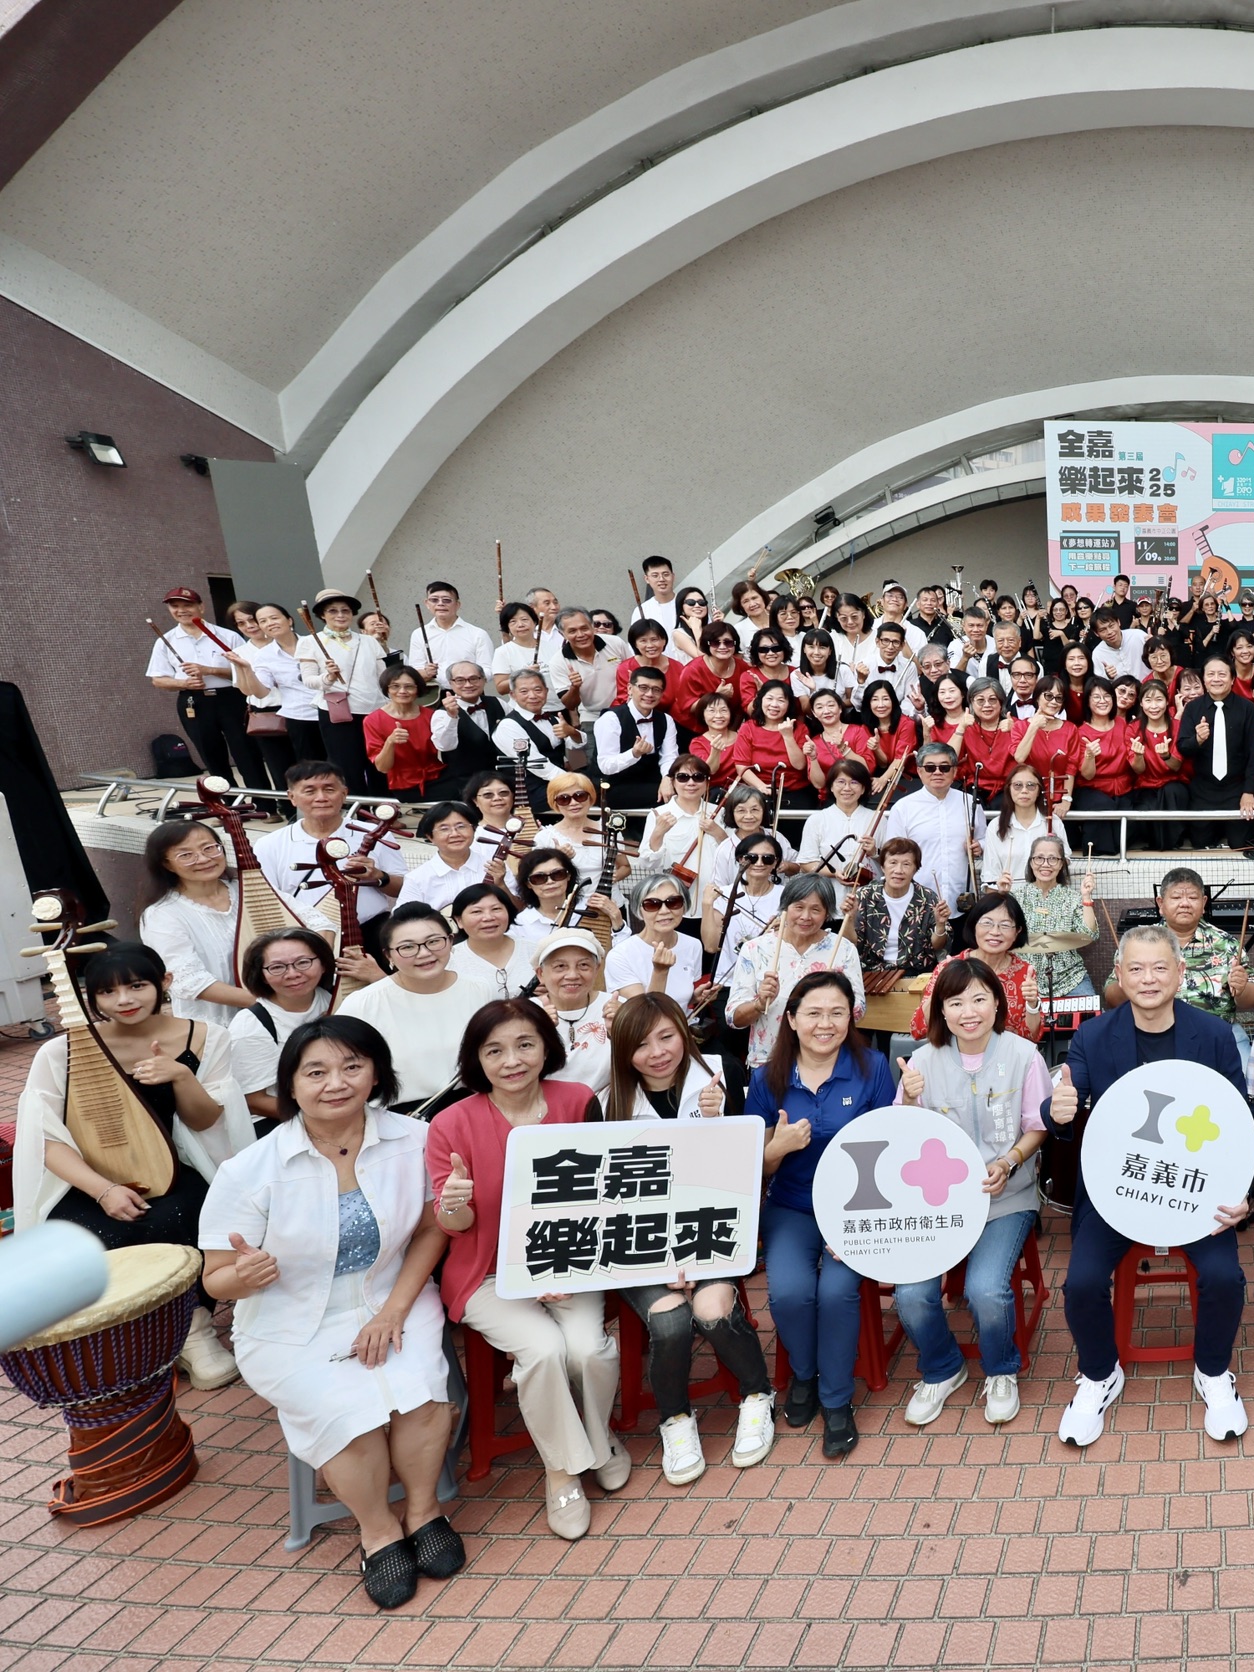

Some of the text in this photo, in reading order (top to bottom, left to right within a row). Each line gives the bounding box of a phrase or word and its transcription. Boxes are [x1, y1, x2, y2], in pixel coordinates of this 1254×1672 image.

[1057, 430, 1114, 459] 全嘉
[1118, 451, 1144, 461] 第三屆
[1058, 466, 1145, 496] 樂起來
[1061, 503, 1178, 523] 成果發表會
[531, 1145, 674, 1209] 全嘉
[1121, 1152, 1208, 1194] 嘉義市
[1115, 1185, 1200, 1214] CHIAYI CITY
[842, 1214, 964, 1234] 嘉義市政府衛生局
[525, 1207, 741, 1281] 樂起來
[843, 1235, 936, 1247] PUBLIC HEALTH BUREAU
[843, 1247, 891, 1257] CHIAYI CITY
